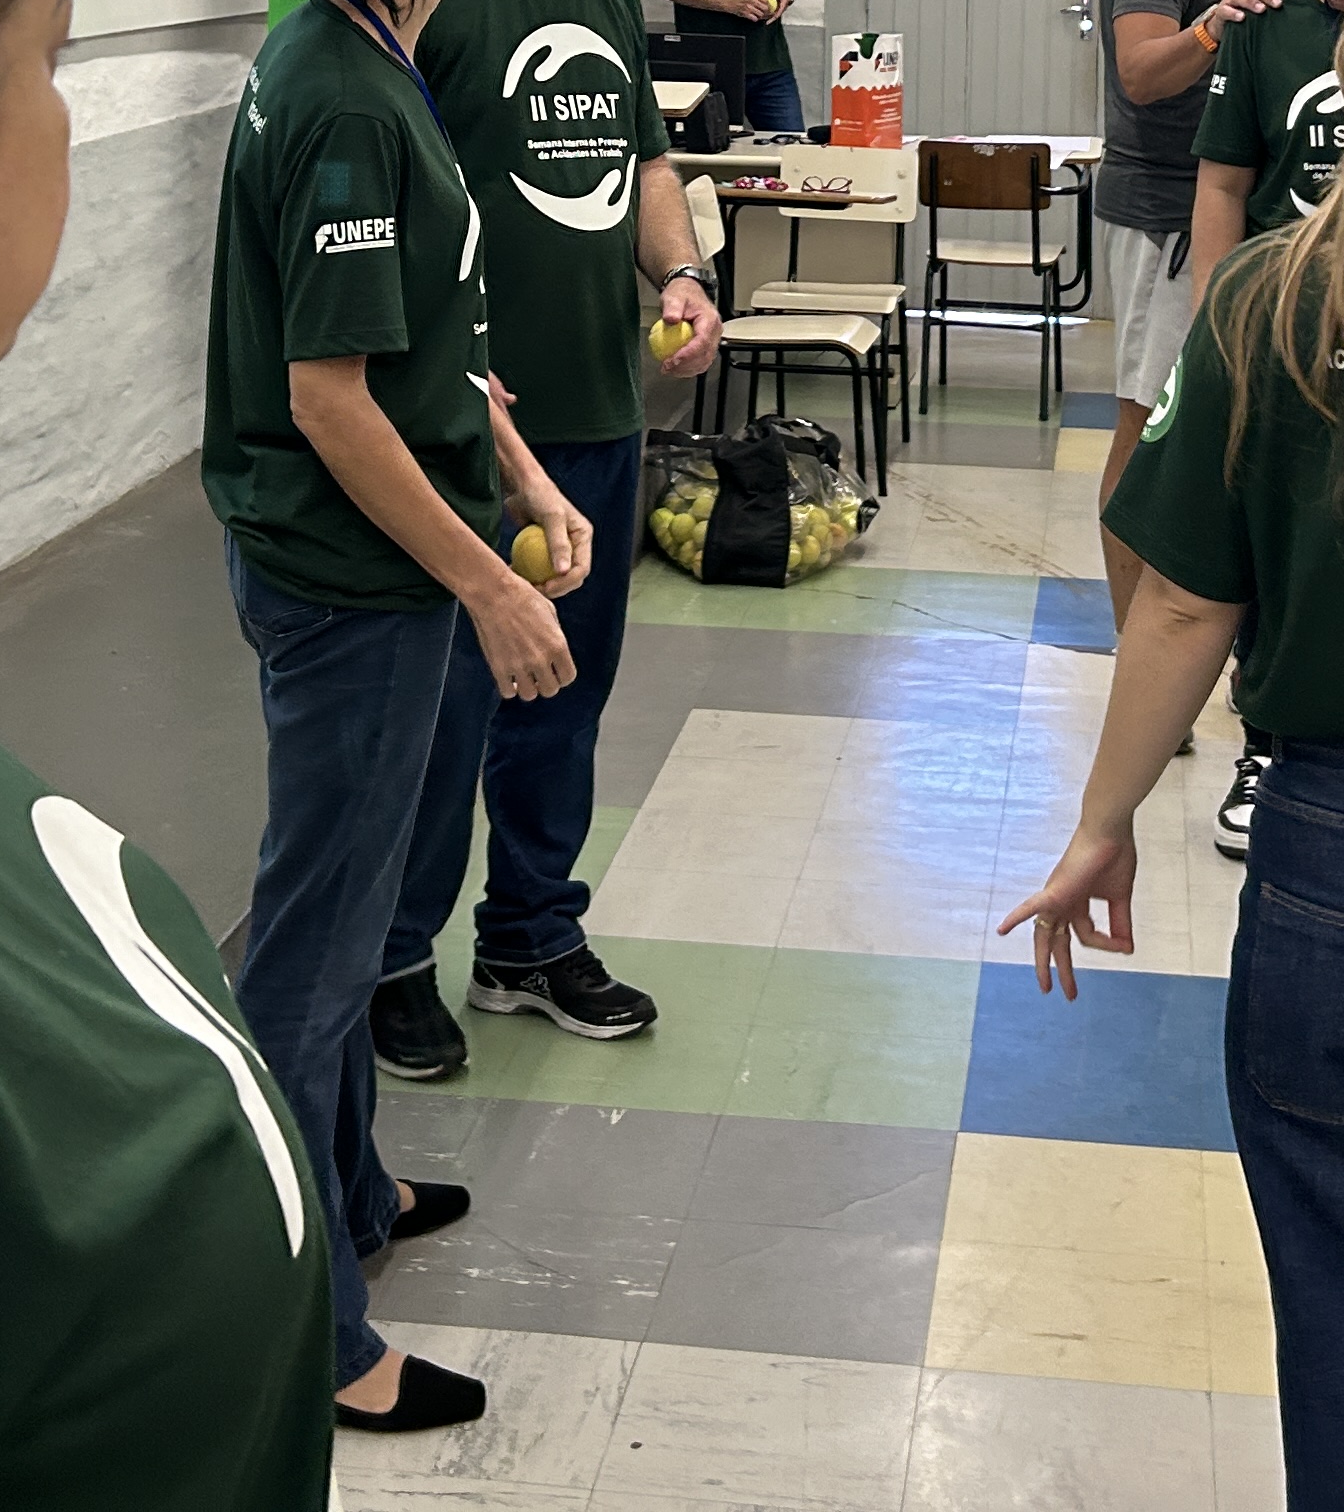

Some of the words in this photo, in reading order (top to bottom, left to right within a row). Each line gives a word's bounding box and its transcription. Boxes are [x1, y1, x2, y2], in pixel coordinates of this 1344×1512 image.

[529, 94, 548, 122] II
[553, 93, 620, 122] SIPAT
[1308, 124, 1325, 148] II
